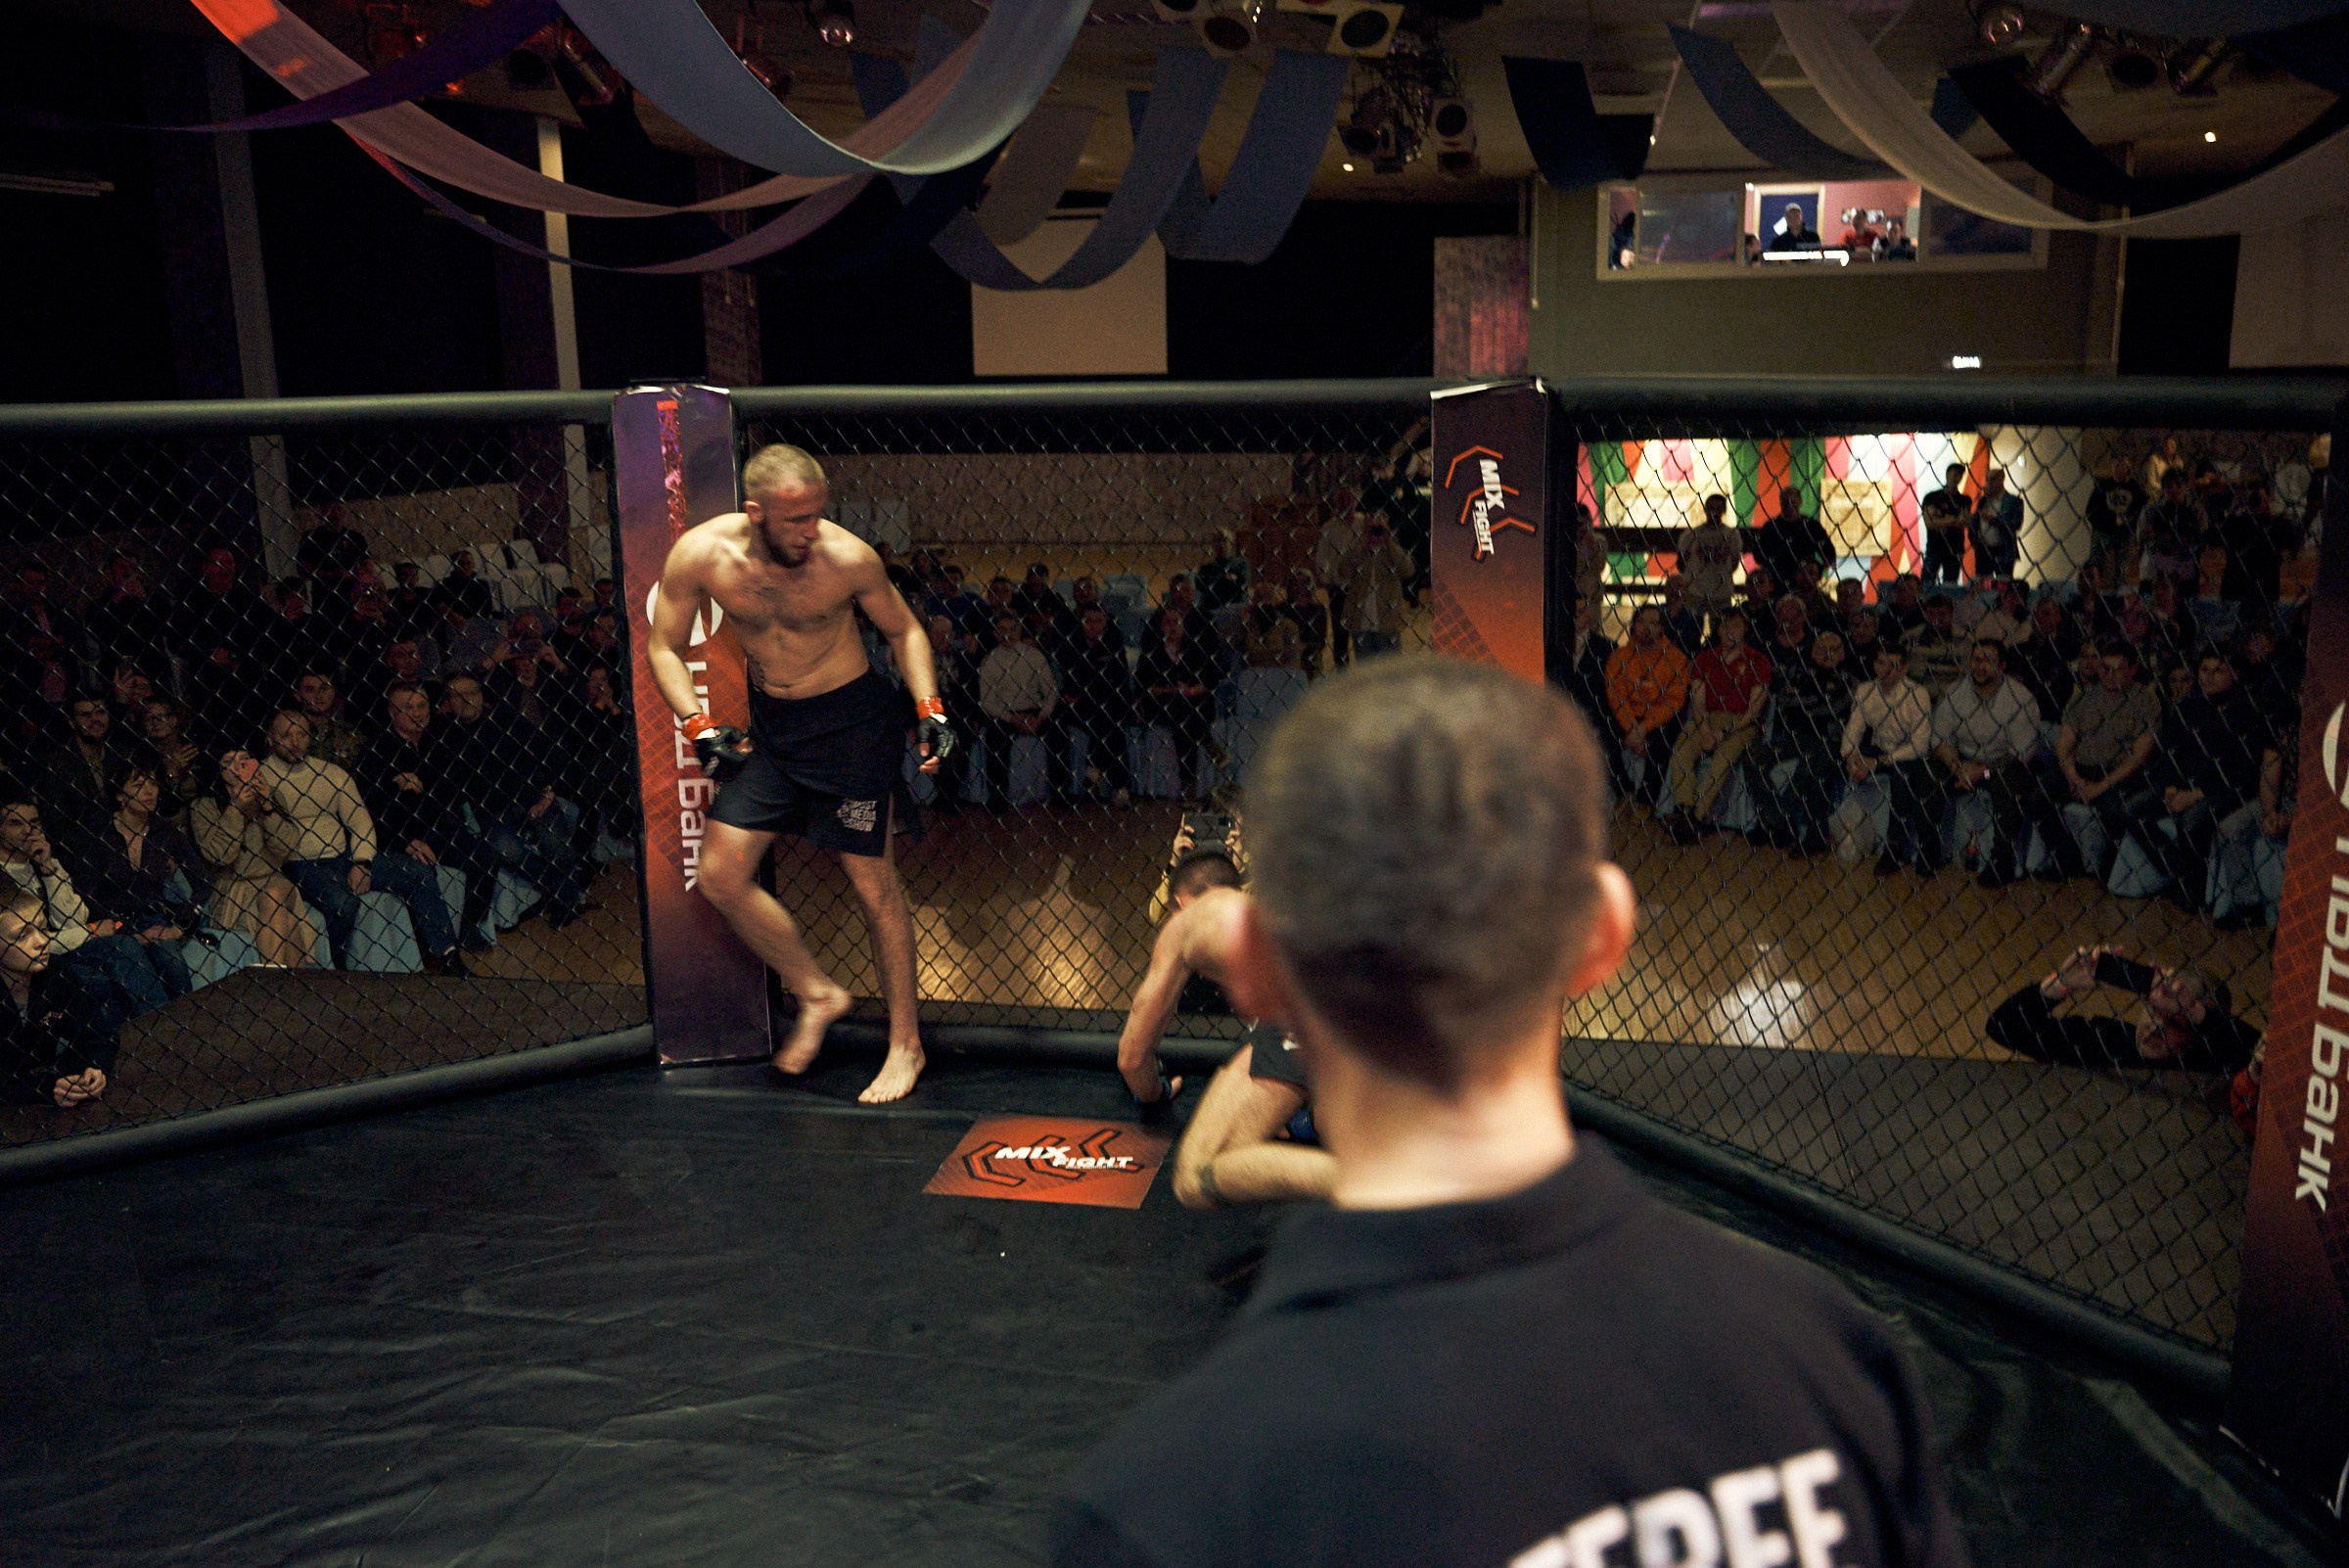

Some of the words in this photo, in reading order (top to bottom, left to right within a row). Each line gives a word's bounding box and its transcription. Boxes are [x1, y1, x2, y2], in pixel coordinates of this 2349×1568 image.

[1480, 459, 1505, 510] MIX
[1475, 500, 1495, 555] FIGHT
[2295, 1023, 2349, 1213] Банк
[994, 1145, 1072, 1160] MIX
[1052, 1155, 1134, 1170] FIGHT
